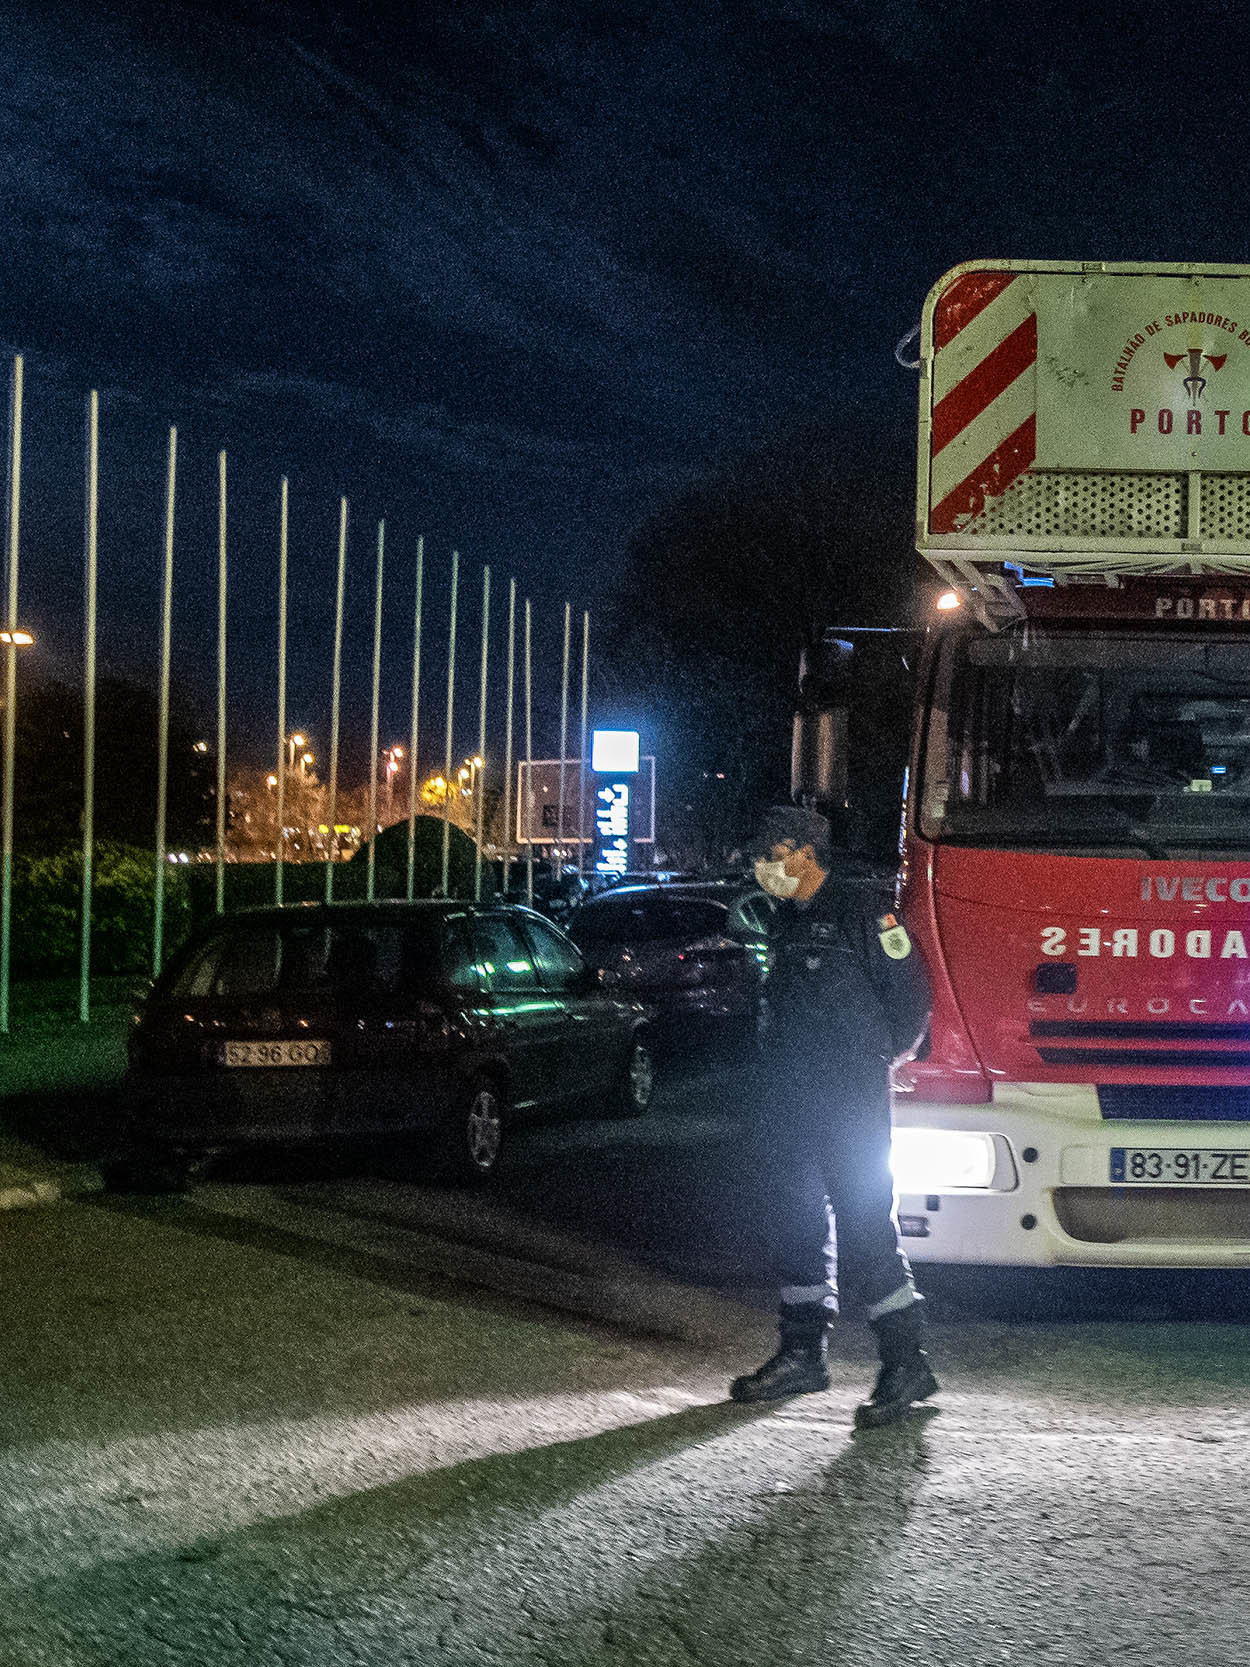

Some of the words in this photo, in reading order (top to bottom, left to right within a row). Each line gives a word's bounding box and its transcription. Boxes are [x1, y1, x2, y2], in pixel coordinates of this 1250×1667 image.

[1111, 334, 1145, 393] BATALHÃO
[1145, 321, 1163, 336] DE
[1165, 312, 1238, 333] SAPADORES
[1131, 1152, 1249, 1180] 83-91-ZE
